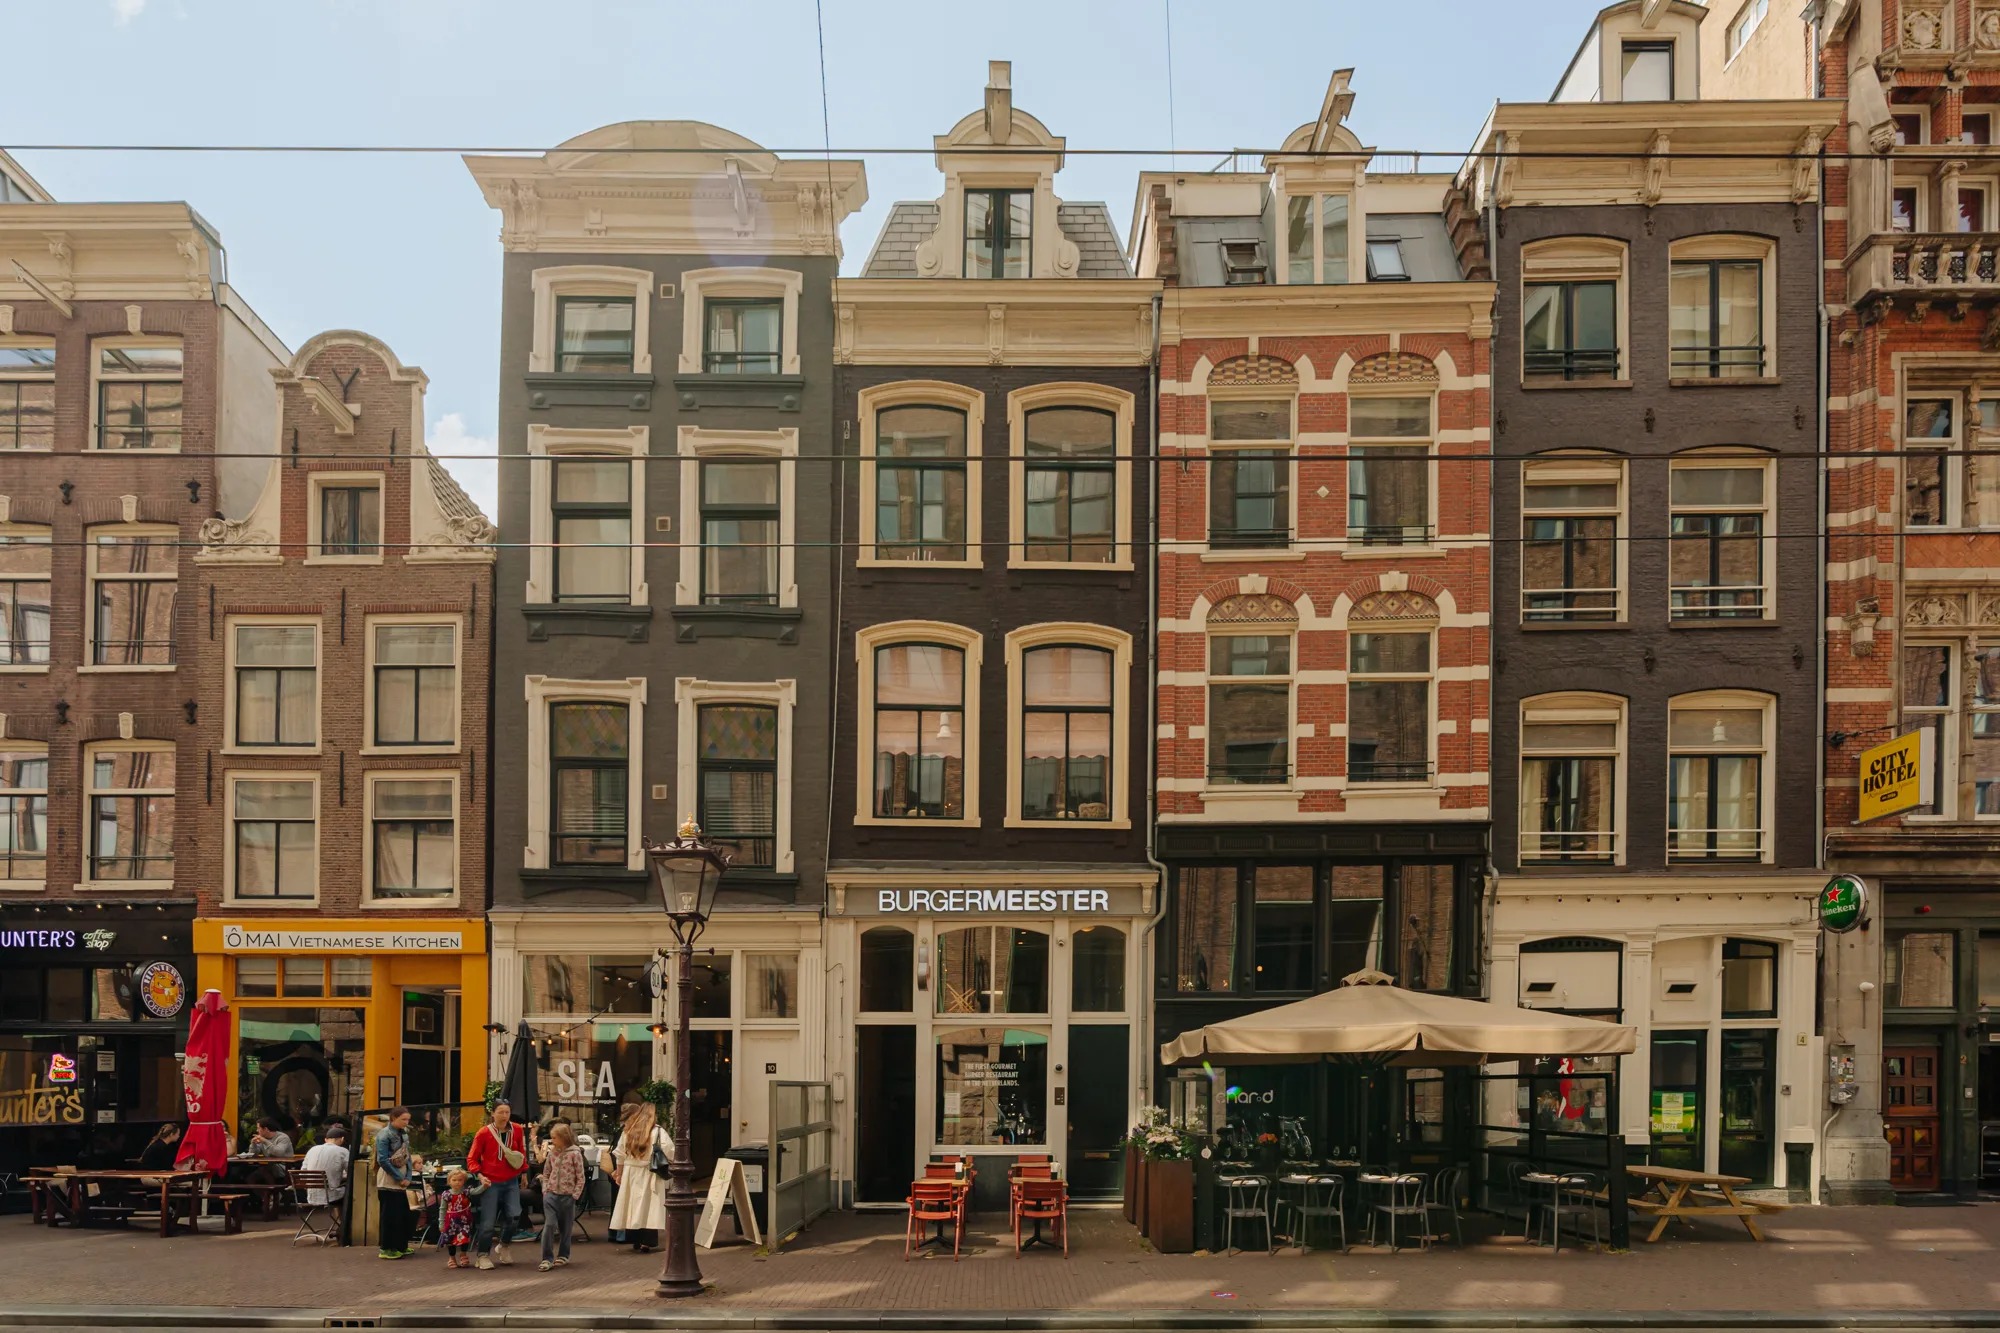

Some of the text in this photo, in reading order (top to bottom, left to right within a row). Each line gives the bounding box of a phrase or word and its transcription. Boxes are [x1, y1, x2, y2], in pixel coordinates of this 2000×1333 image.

[1870, 748, 1909, 775] CITY
[1864, 761, 1917, 794] HOTEL
[878, 889, 1109, 912] BURGERMEESTER
[82, 928, 116, 941] coffee
[246, 933, 281, 947] MAI
[85, 939, 110, 952] shop
[143, 964, 181, 984] HUNTER'S
[557, 1060, 617, 1098] SLA
